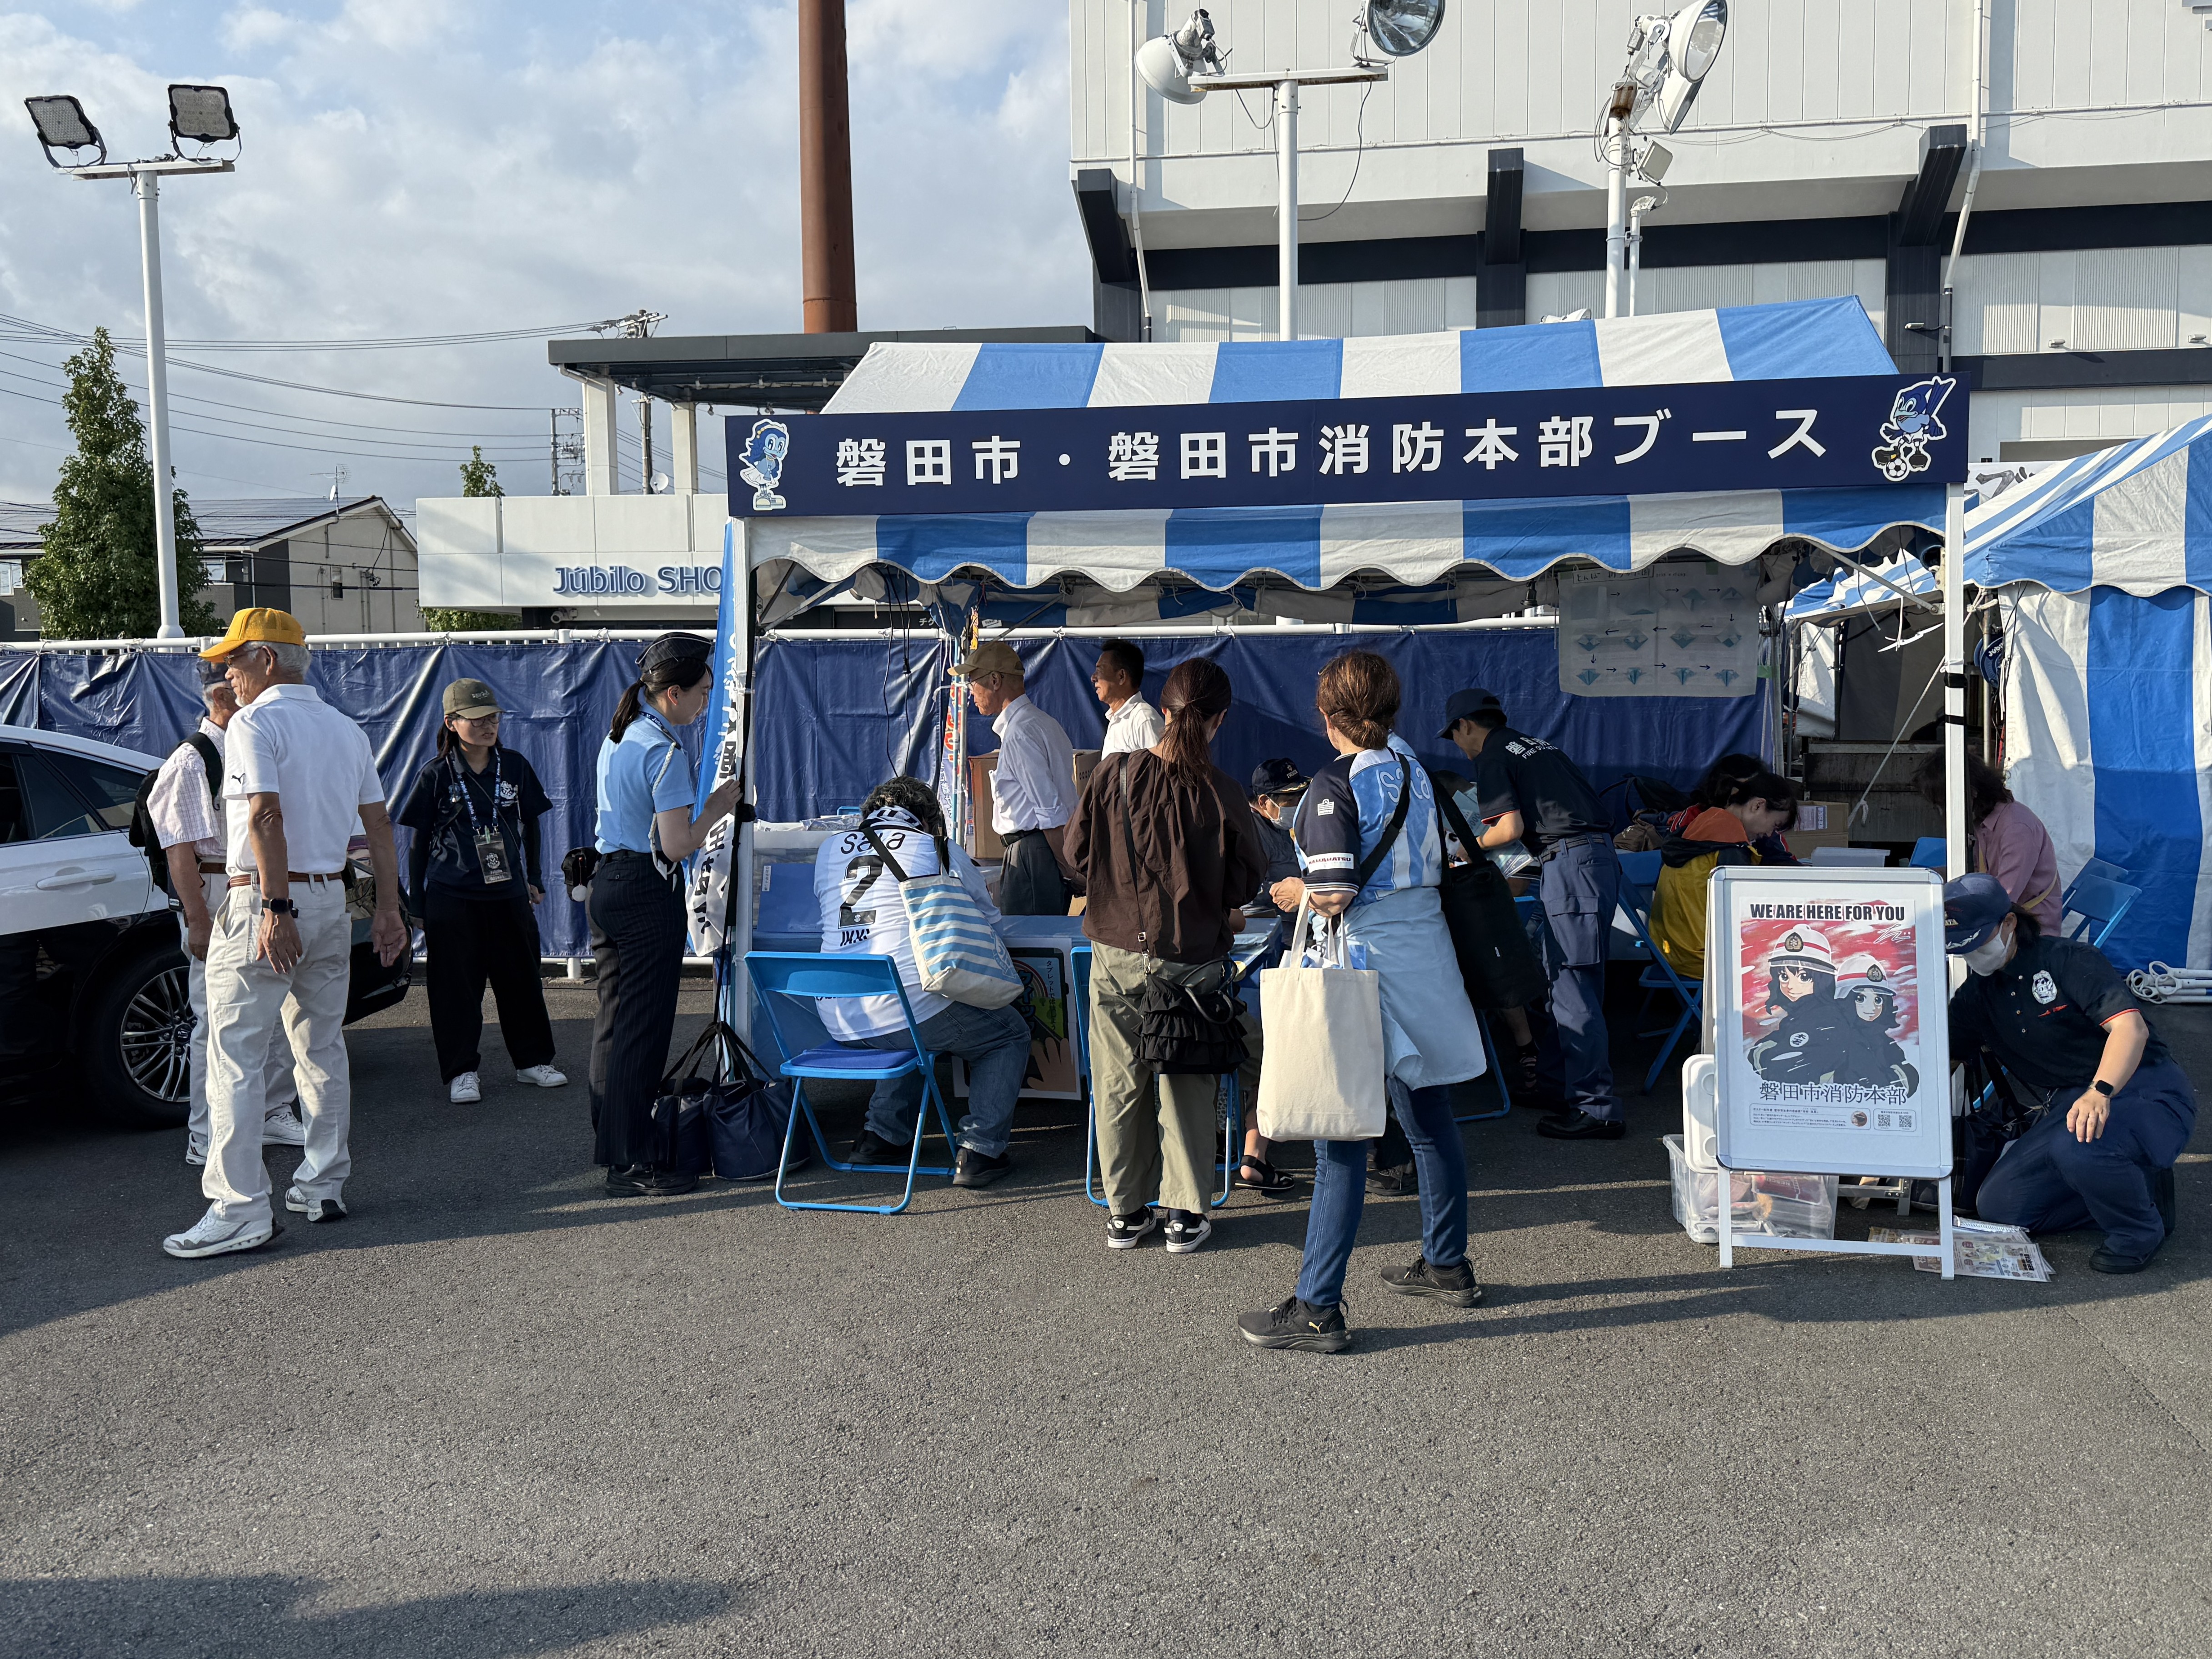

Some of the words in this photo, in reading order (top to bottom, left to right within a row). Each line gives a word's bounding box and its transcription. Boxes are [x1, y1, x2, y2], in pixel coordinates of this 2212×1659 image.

[835, 407, 1827, 487] 磐田市・磐田市消防本部ブース
[553, 566, 645, 593] Júbilo
[657, 566, 723, 592] SHO
[838, 854, 884, 929] 2
[1751, 904, 1773, 918] WE
[1775, 904, 1803, 919] ARE
[1806, 905, 1842, 920] HERE
[1845, 906, 1872, 920] FOR
[1875, 906, 1905, 921] YOU
[1759, 1082, 1909, 1105] 磐田市消防本部
